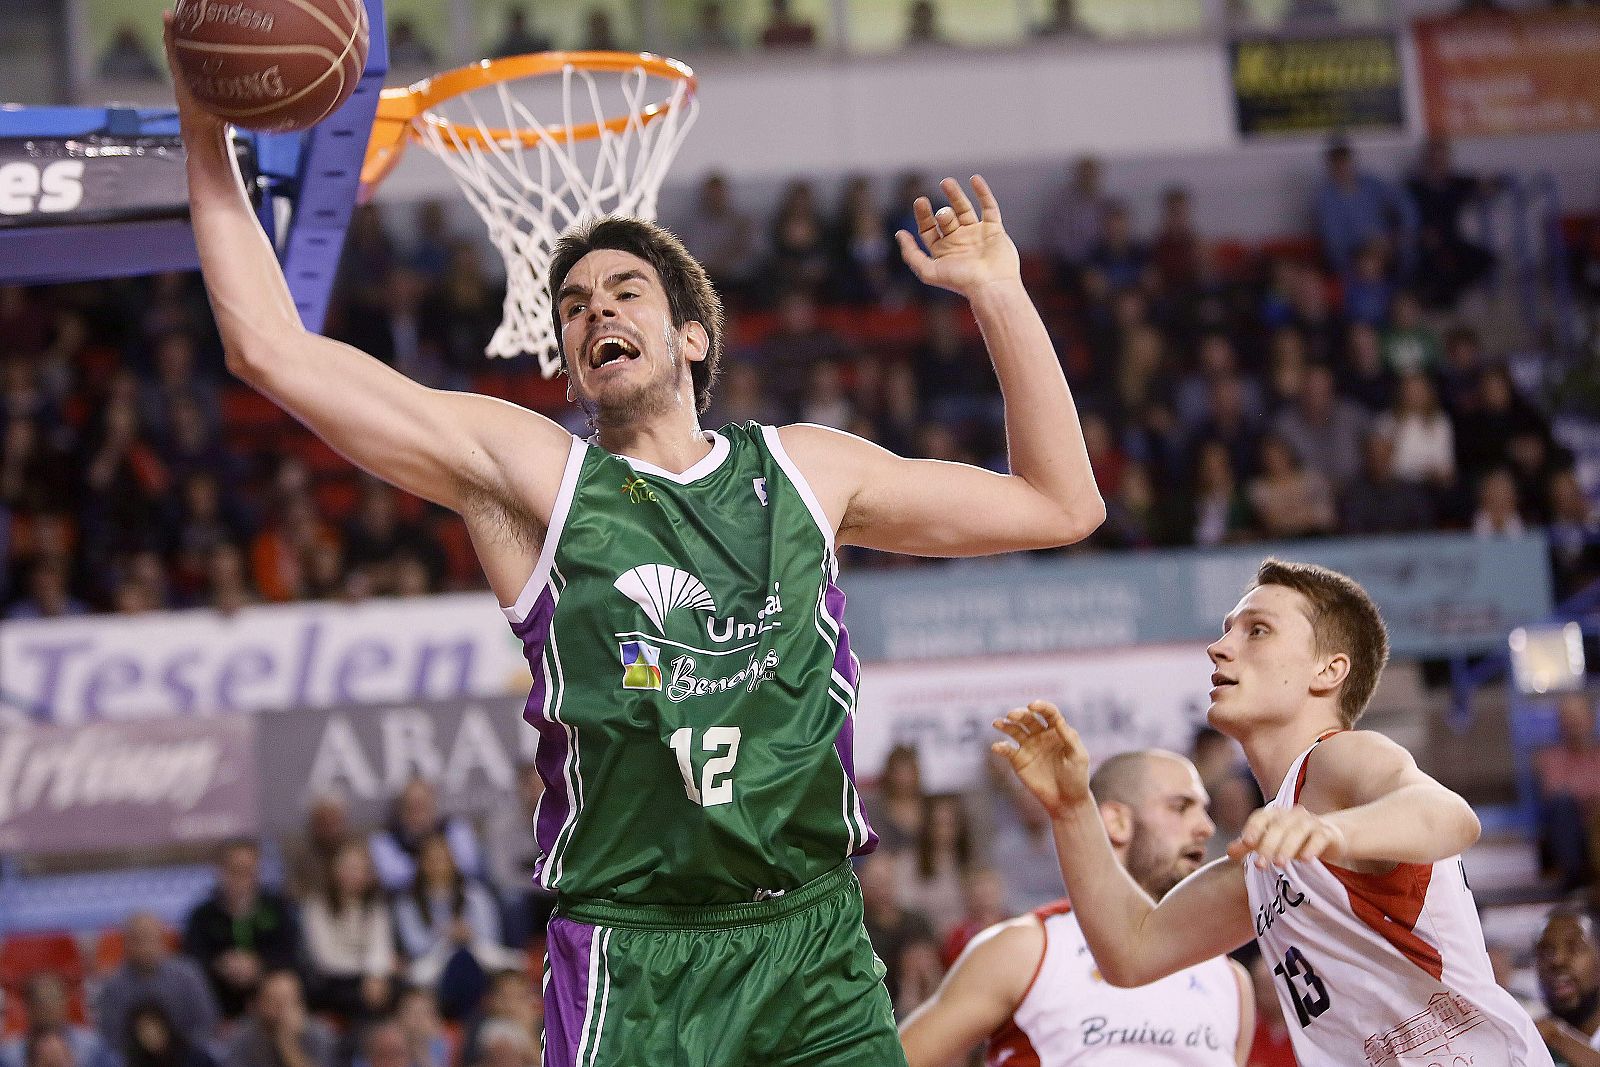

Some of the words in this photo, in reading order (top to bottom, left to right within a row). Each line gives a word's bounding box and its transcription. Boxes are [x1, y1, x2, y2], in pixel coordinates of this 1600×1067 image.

[669, 726, 742, 807] 12
[1273, 945, 1331, 1029] 13
[1080, 1016, 1177, 1047] Bruixa
